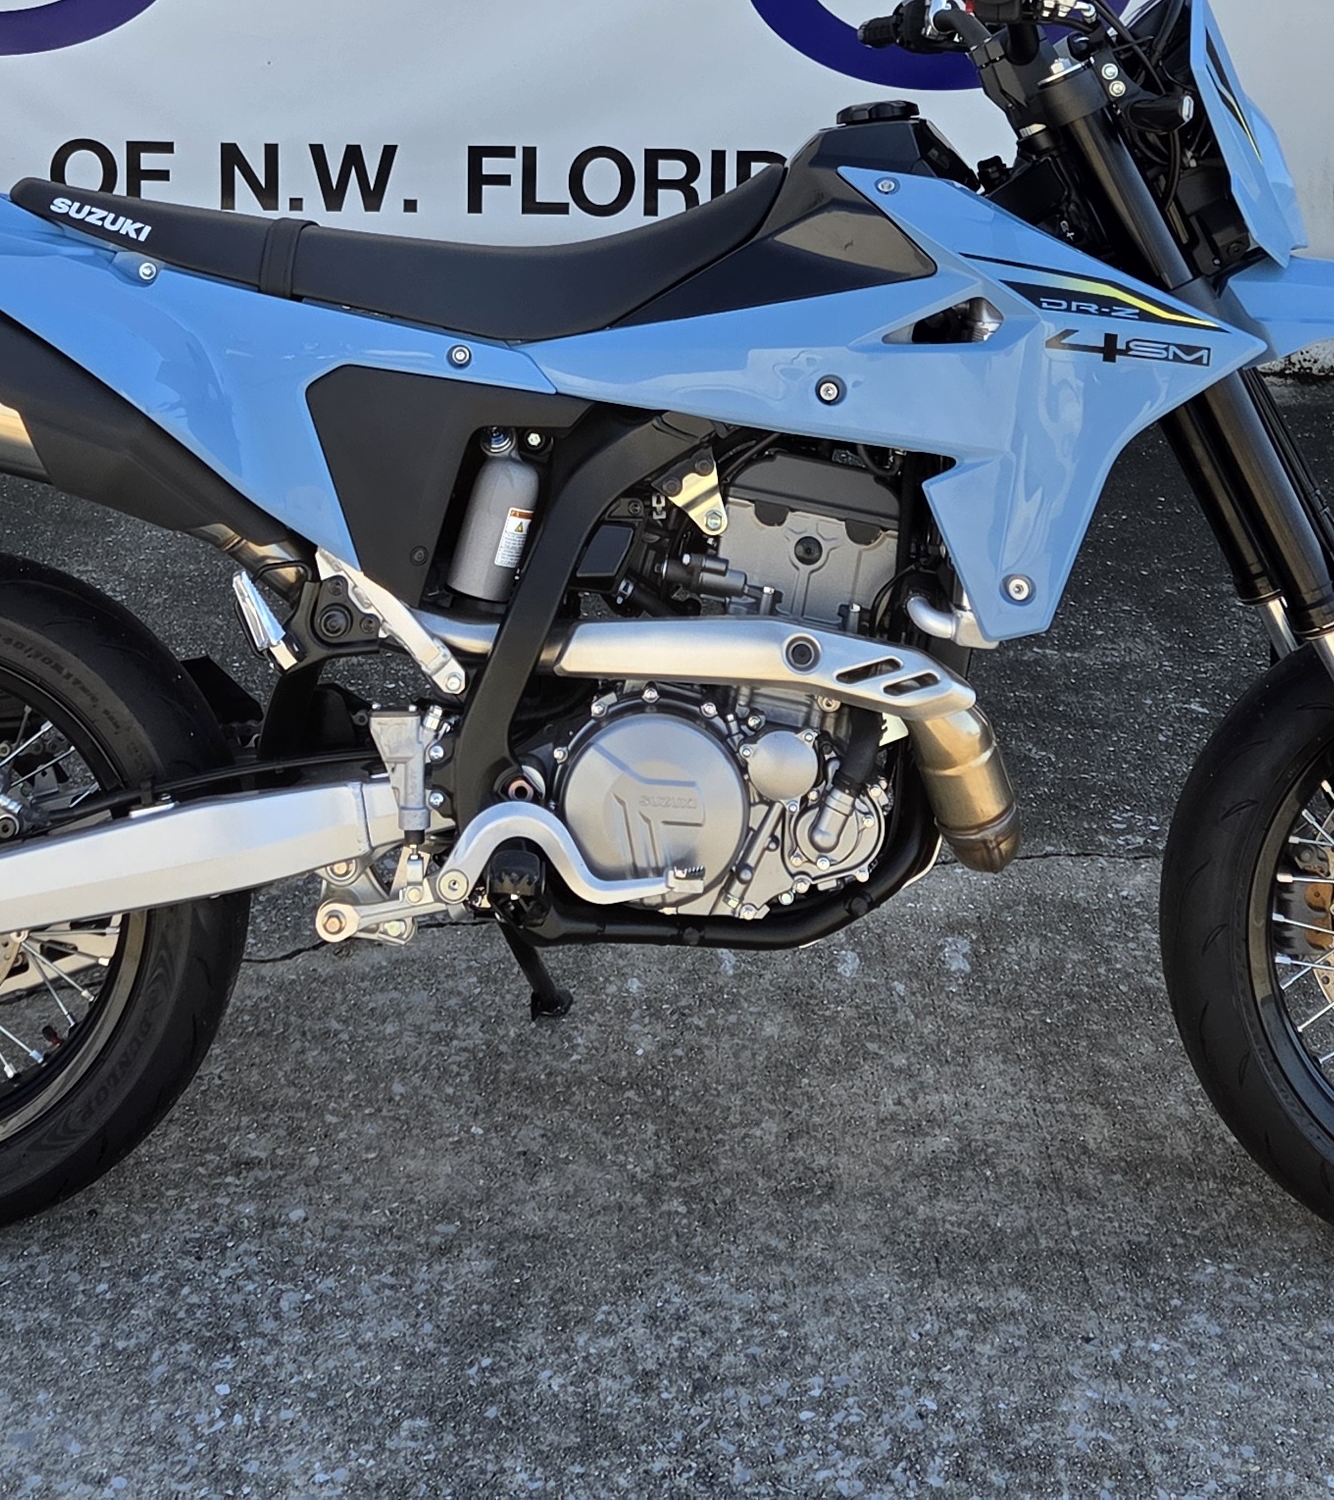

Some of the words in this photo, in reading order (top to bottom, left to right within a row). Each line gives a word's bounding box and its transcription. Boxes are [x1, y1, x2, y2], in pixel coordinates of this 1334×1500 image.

[50, 138, 175, 199] OF
[220, 142, 418, 213] N.W.
[49, 197, 152, 242] SUZUKI
[1039, 297, 1140, 320] DR-Z
[637, 794, 698, 810] SUZUKI
[74, 1006, 154, 1124] DUNLOP
